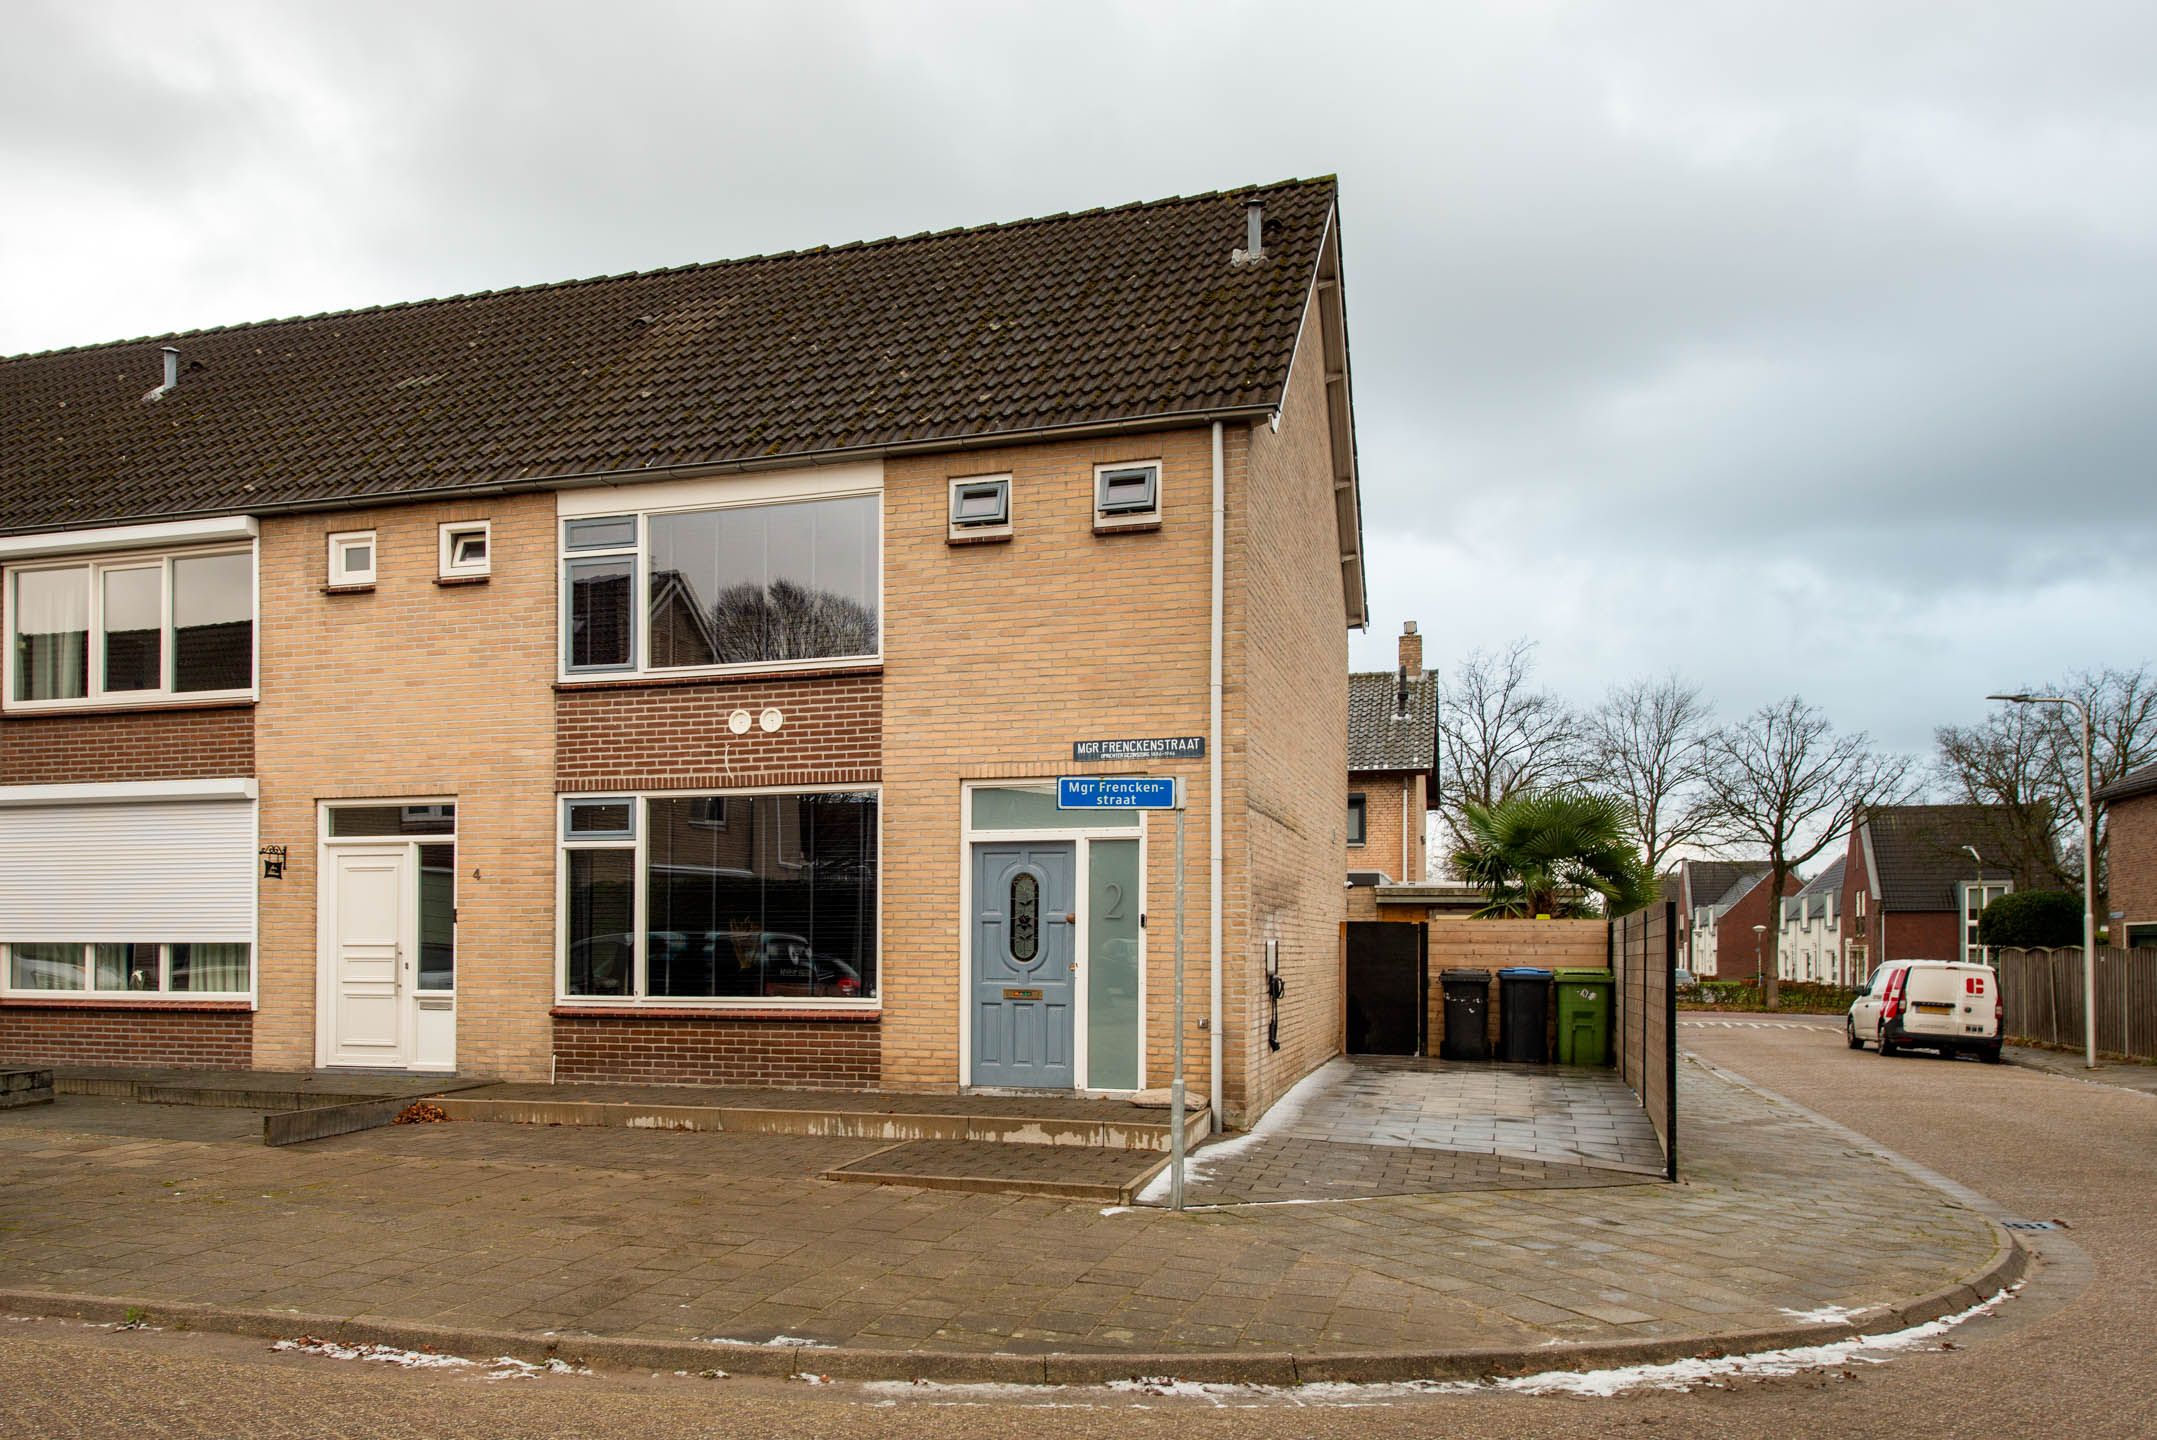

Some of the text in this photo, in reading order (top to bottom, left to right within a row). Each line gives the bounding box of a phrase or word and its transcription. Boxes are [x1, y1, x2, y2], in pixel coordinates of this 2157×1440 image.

[1102, 738, 1200, 753] FRENCKENSTRAAT
[1069, 782, 1165, 795] Mgr Frencken-
[1096, 795, 1137, 805] straat
[472, 869, 480, 880] 4
[1104, 882, 1124, 920] 2
